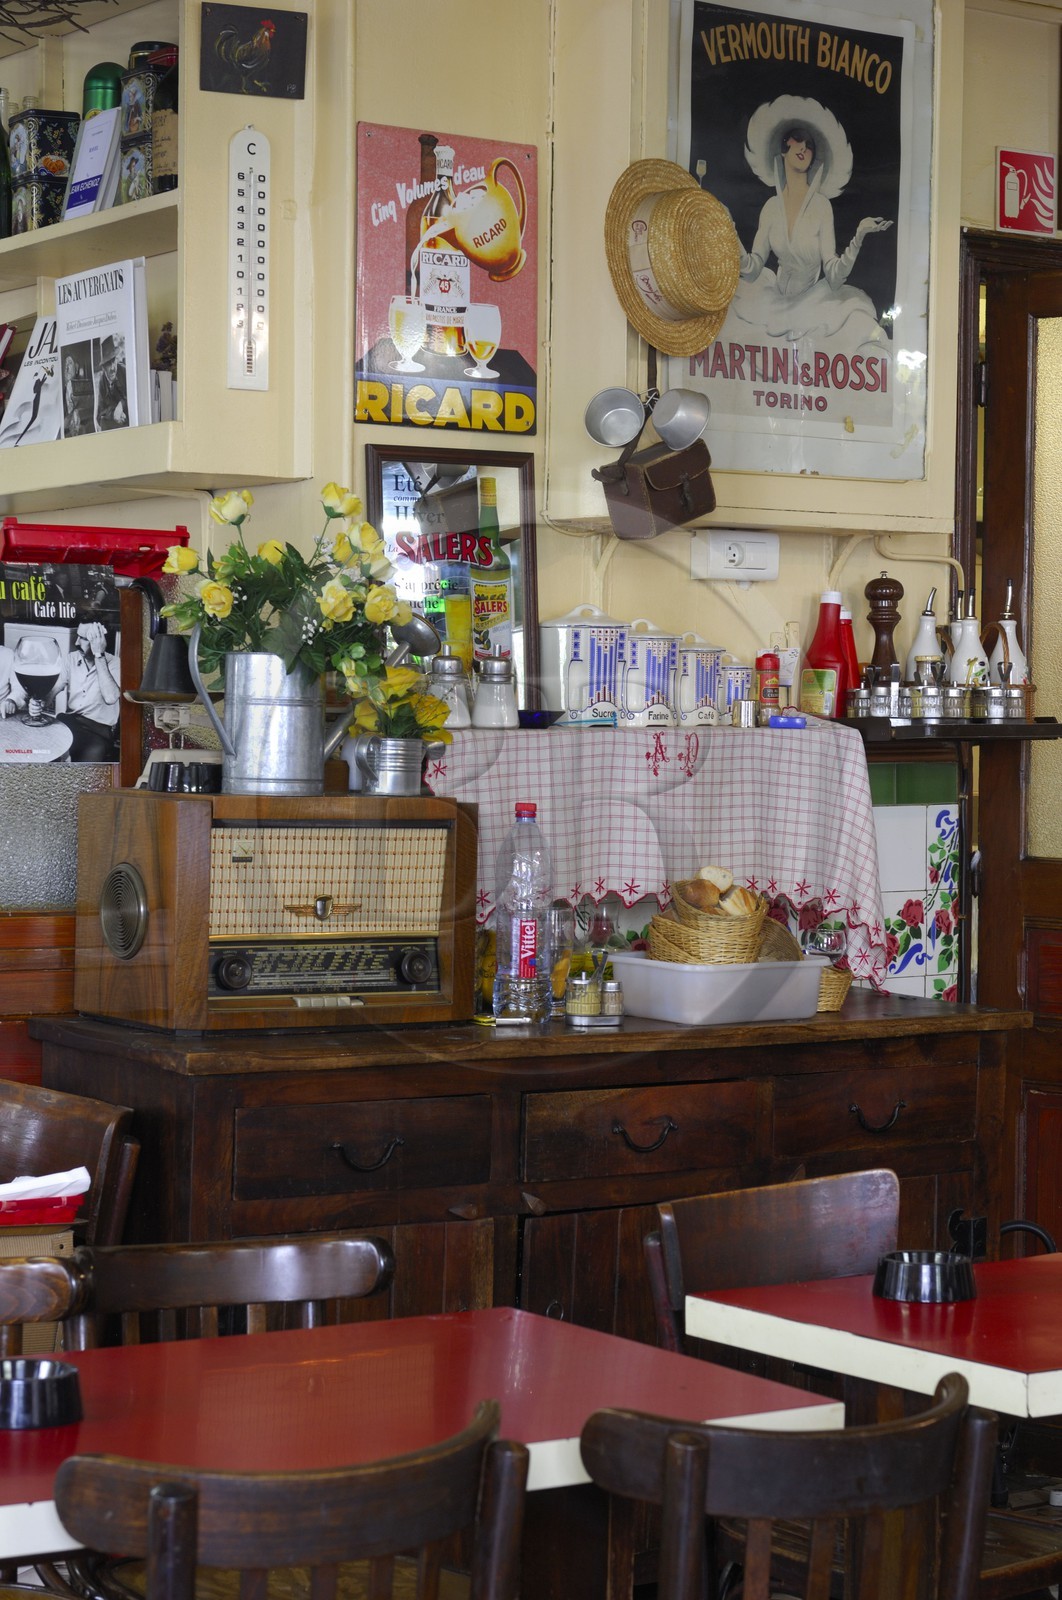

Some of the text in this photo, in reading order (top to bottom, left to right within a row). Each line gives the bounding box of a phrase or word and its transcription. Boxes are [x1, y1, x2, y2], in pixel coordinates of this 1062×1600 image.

[701, 22, 892, 94] VERMOUTH BIANCO
[247, 143, 256, 155] C
[371, 165, 486, 227] Cinq Volumes d'eau
[473, 218, 508, 249] RICARD
[422, 251, 468, 267] RICARD
[58, 268, 124, 305] LES AUVERGNATS
[440, 281, 449, 292] 45
[433, 305, 458, 313] FRANCE
[28, 321, 58, 359] JA
[689, 341, 799, 386] MARTINI
[814, 352, 888, 393] ROSSI
[356, 381, 535, 433] RICARD
[753, 390, 828, 412] TORINO
[388, 531, 494, 567] La SALERS
[12, 576, 46, 601] café
[34, 600, 76, 618] Café life
[474, 600, 508, 615] SALERS
[648, 711, 669, 720] Farine
[697, 711, 715, 720] Café
[521, 921, 536, 959] Vittel
